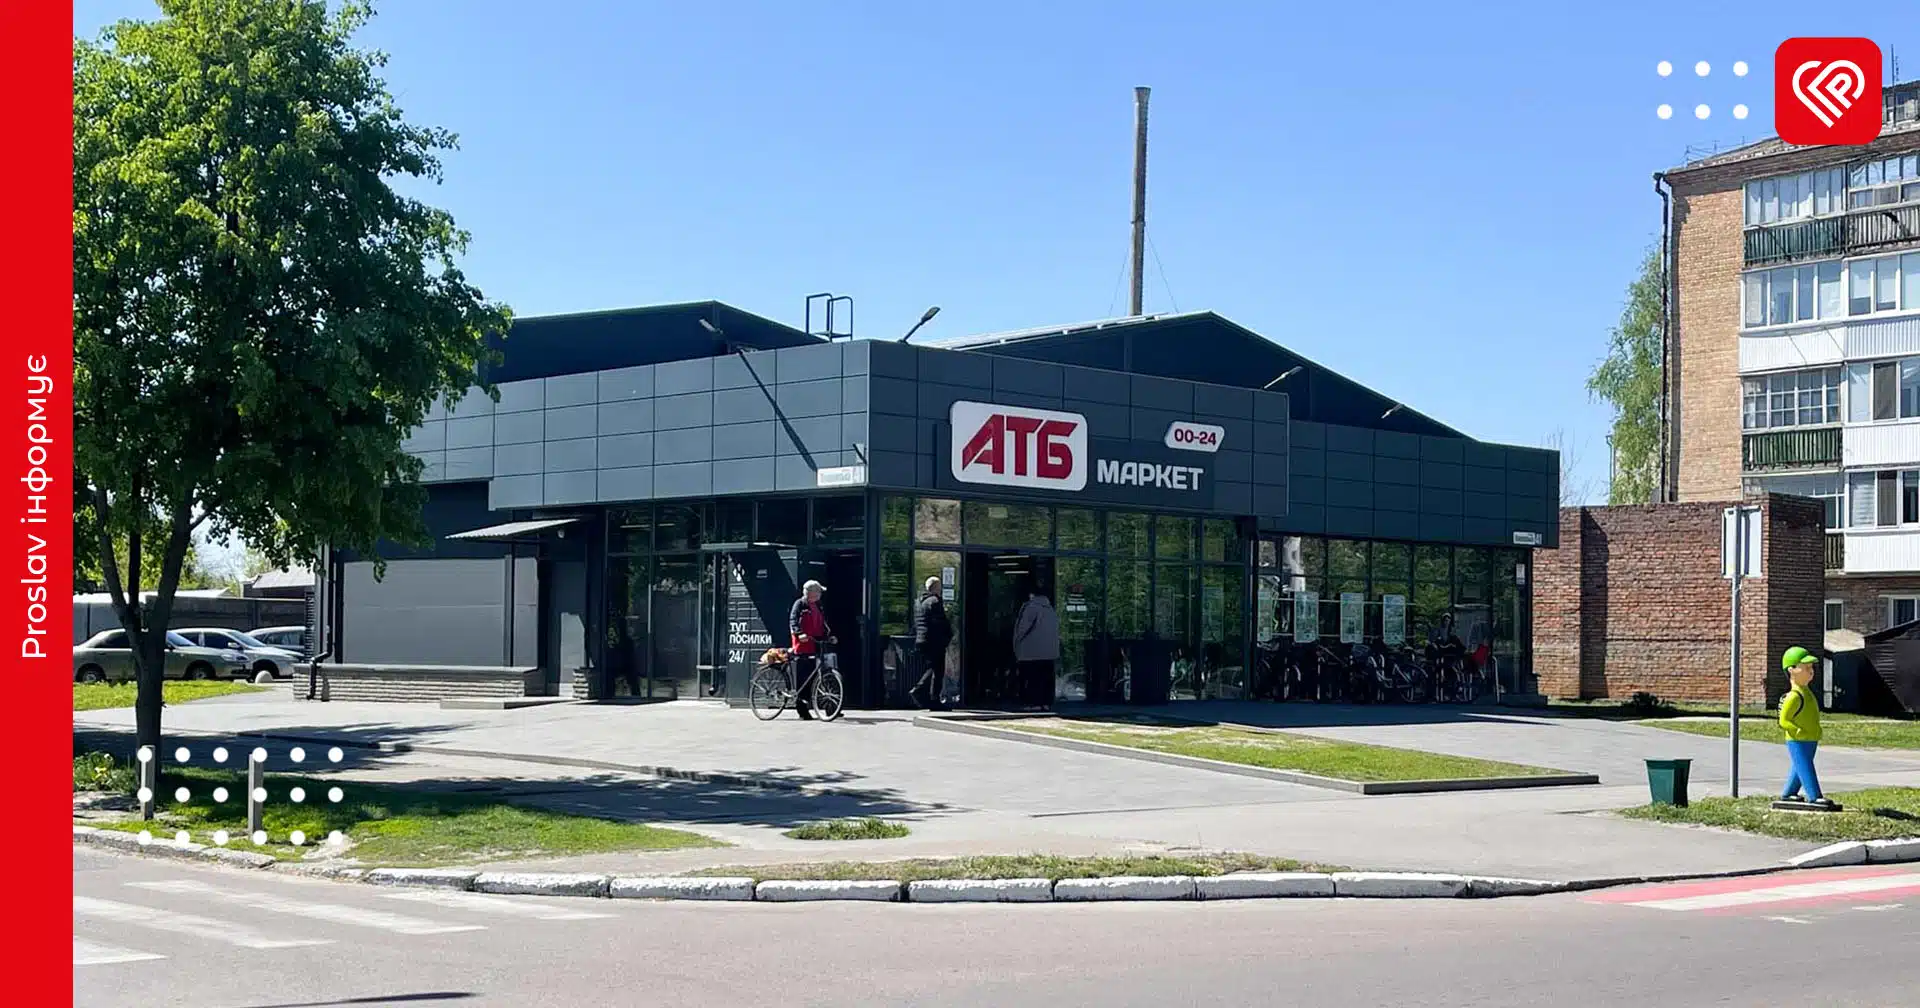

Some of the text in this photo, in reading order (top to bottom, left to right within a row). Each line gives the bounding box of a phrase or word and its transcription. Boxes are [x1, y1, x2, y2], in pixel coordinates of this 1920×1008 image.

[962, 414, 1078, 480] АТБ
[1174, 428, 1217, 446] 00-24
[1097, 459, 1204, 490] МАРКЕТ
